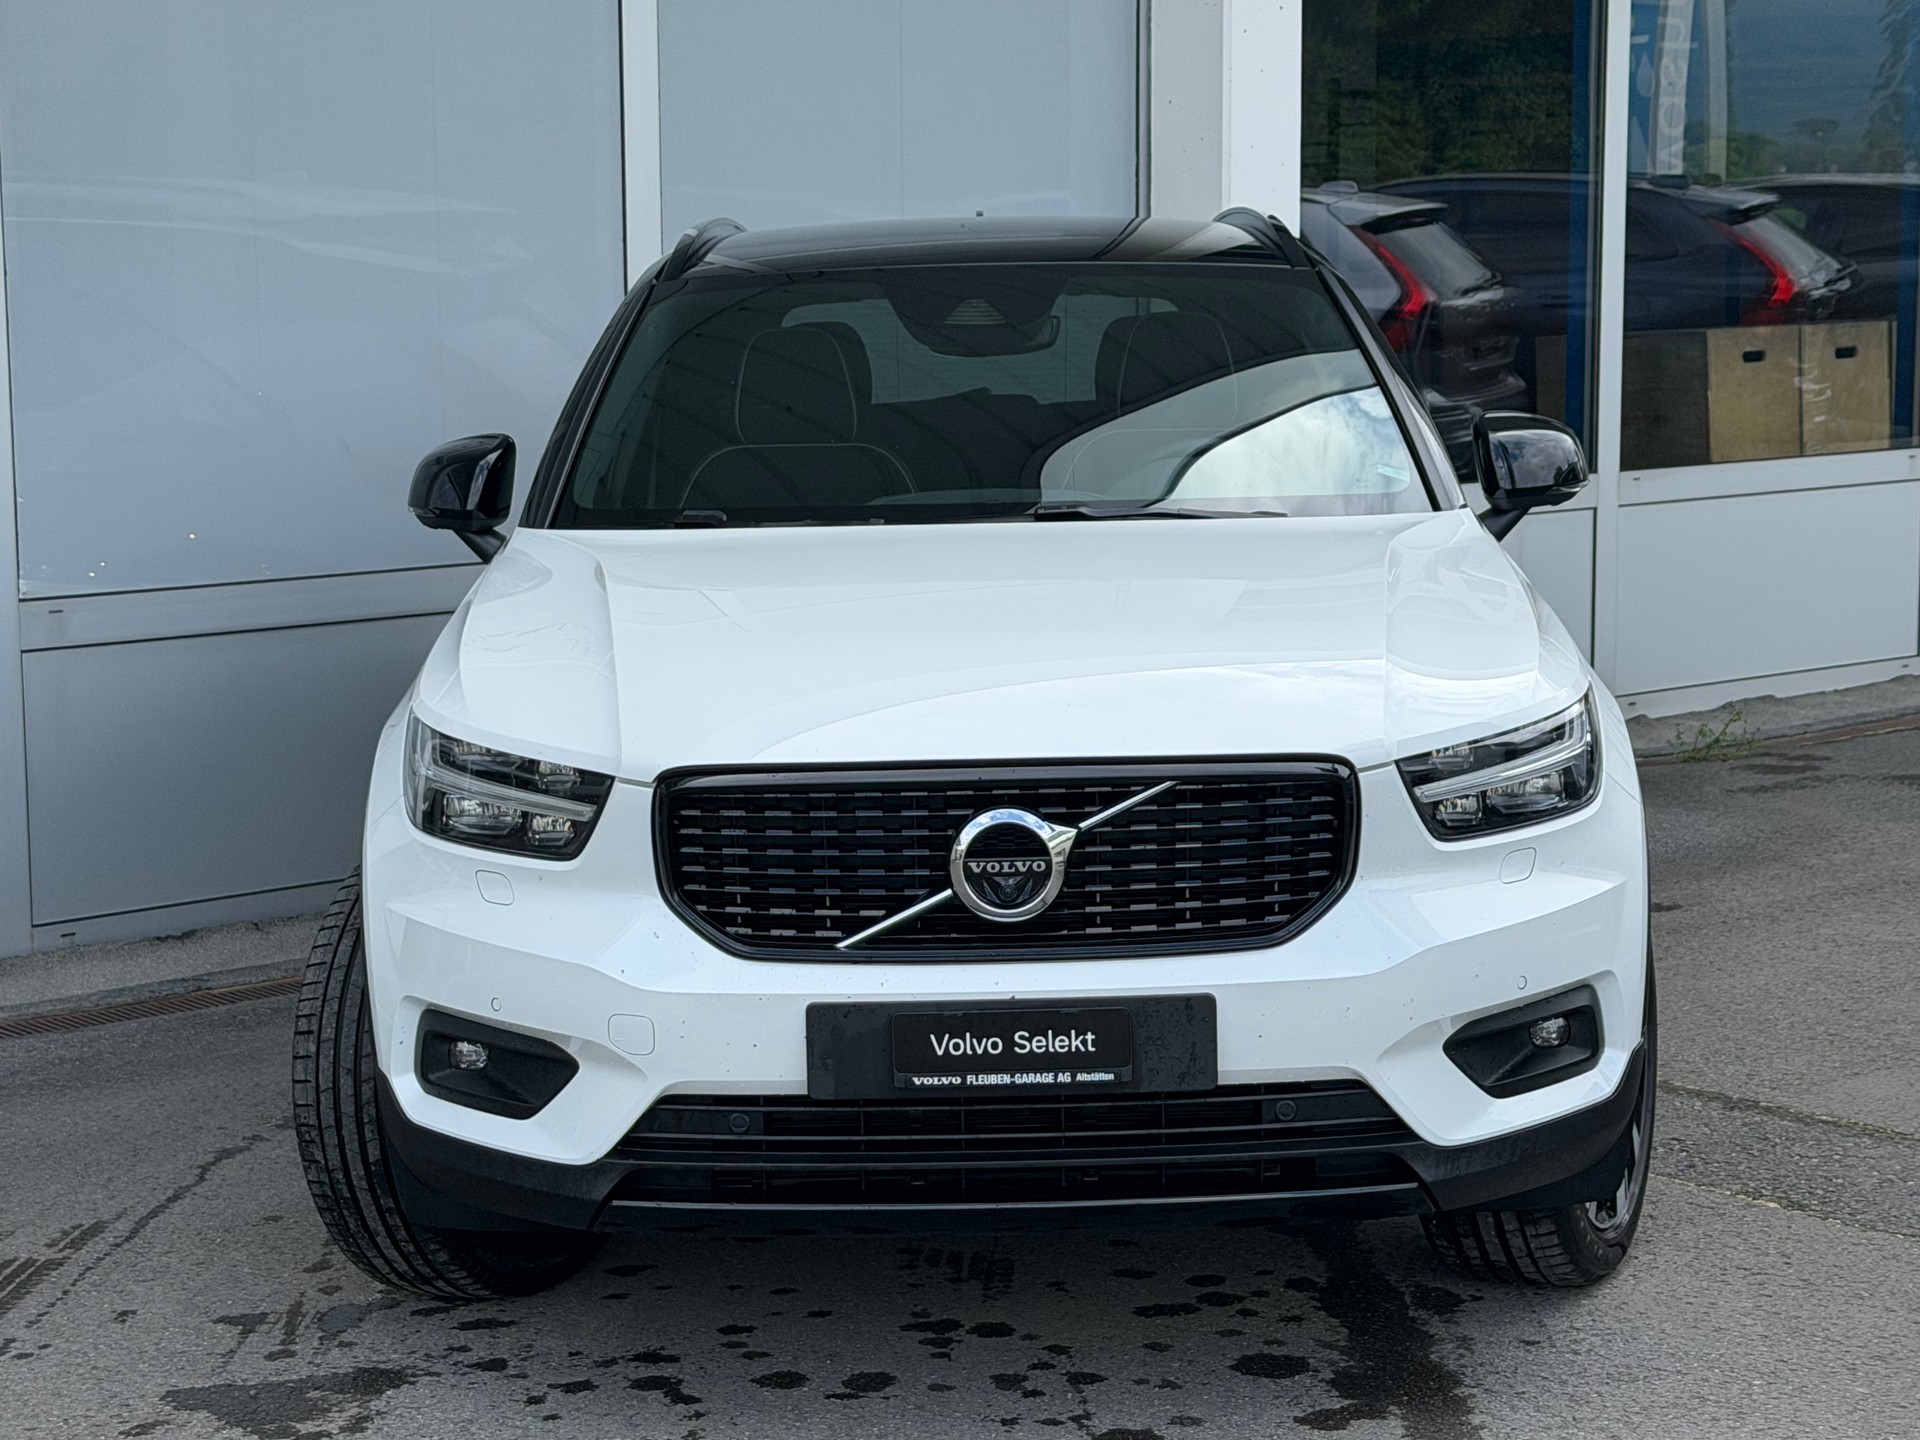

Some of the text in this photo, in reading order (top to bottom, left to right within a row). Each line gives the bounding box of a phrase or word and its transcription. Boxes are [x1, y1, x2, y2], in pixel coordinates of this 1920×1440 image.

[967, 860, 1047, 873] VOLVO
[929, 1029, 1096, 1056] Volvo Selekt
[911, 1072, 1115, 1086] VOLVO FLEUBEN-GARAGE AG Altstätten
